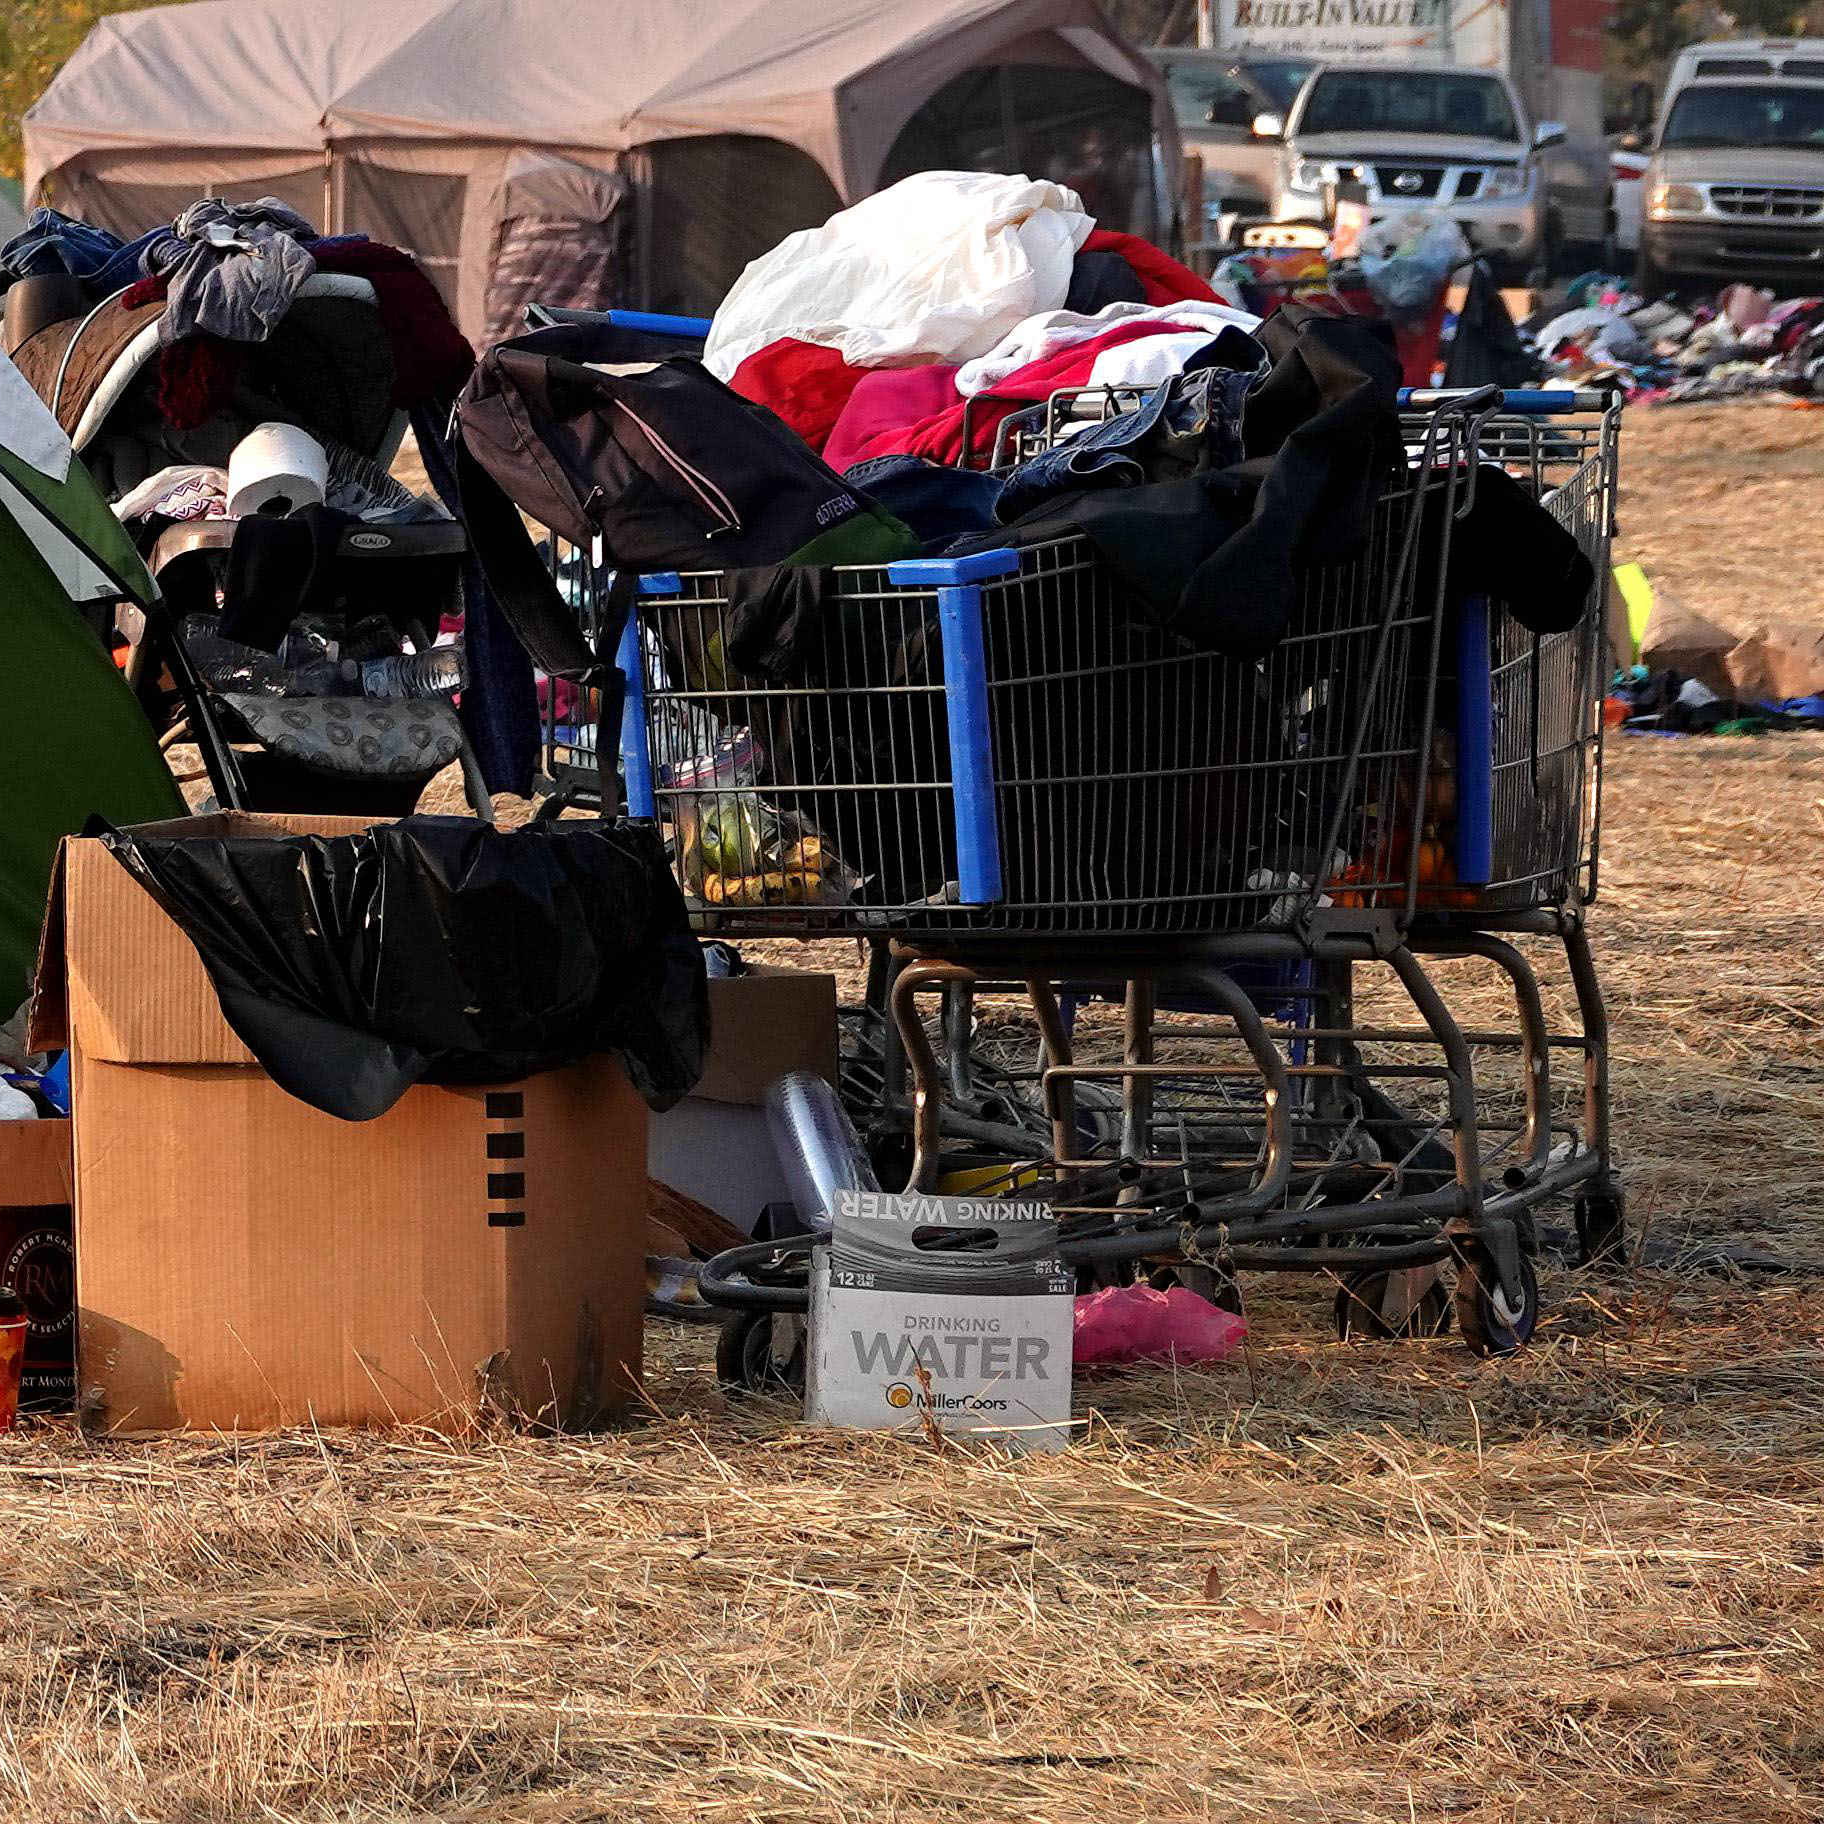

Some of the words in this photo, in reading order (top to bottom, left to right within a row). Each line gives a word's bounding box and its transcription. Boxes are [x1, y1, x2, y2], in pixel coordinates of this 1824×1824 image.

[840, 1192, 947, 1223] WATER
[8, 1235, 41, 1273] ROBERT
[836, 1272, 855, 1285] 12
[905, 1315, 1000, 1332] DRINKING
[851, 1330, 1050, 1380] WATER
[917, 1393, 1007, 1410] MillerCoors
